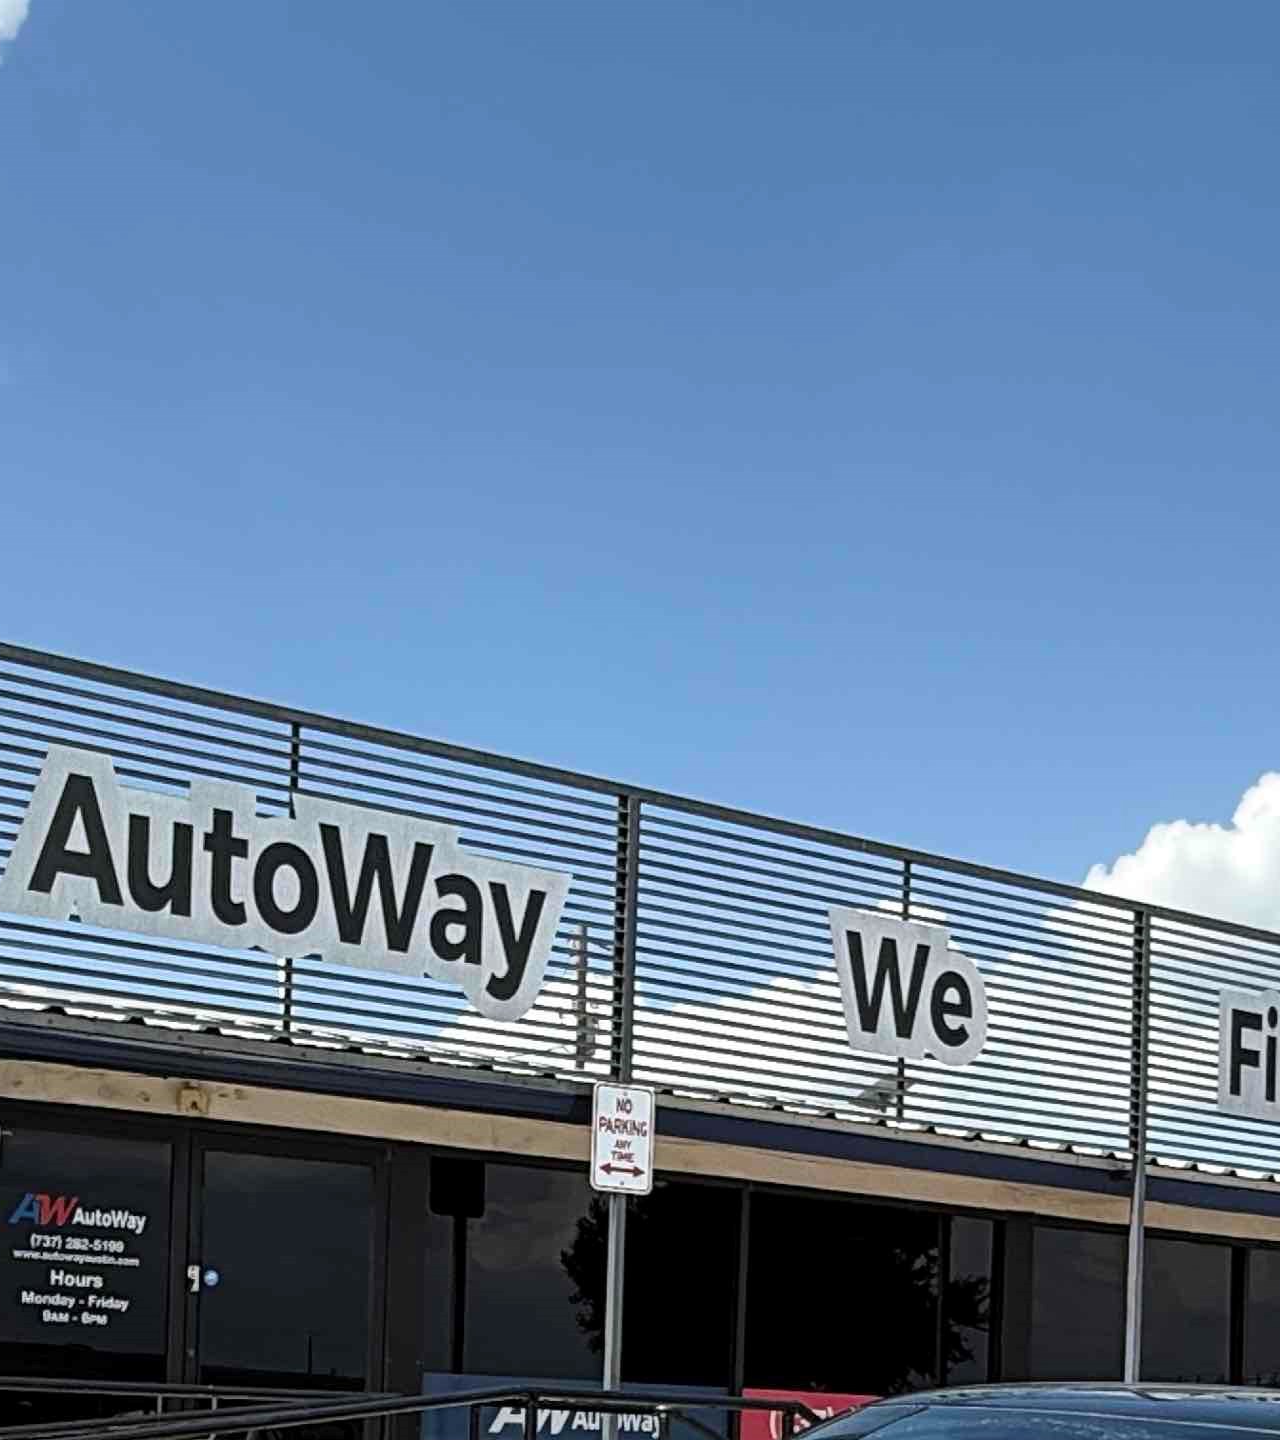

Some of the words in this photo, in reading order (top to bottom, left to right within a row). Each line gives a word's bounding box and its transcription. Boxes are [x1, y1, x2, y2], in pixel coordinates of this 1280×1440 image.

[27, 772, 547, 1002] AutoWay
[842, 927, 975, 1049] We
[616, 1097, 632, 1114] NO
[599, 1116, 648, 1136] PARKING
[615, 1139, 633, 1149] ANY
[611, 1150, 636, 1163] TIME
[8, 1192, 78, 1226] AW
[72, 1207, 146, 1234] AutoWay
[30, 1233, 62, 1249] (737)
[65, 1237, 125, 1253] 282-5199
[50, 1269, 104, 1288] Hours
[21, 1291, 75, 1309] Monday
[87, 1295, 129, 1313] Friday
